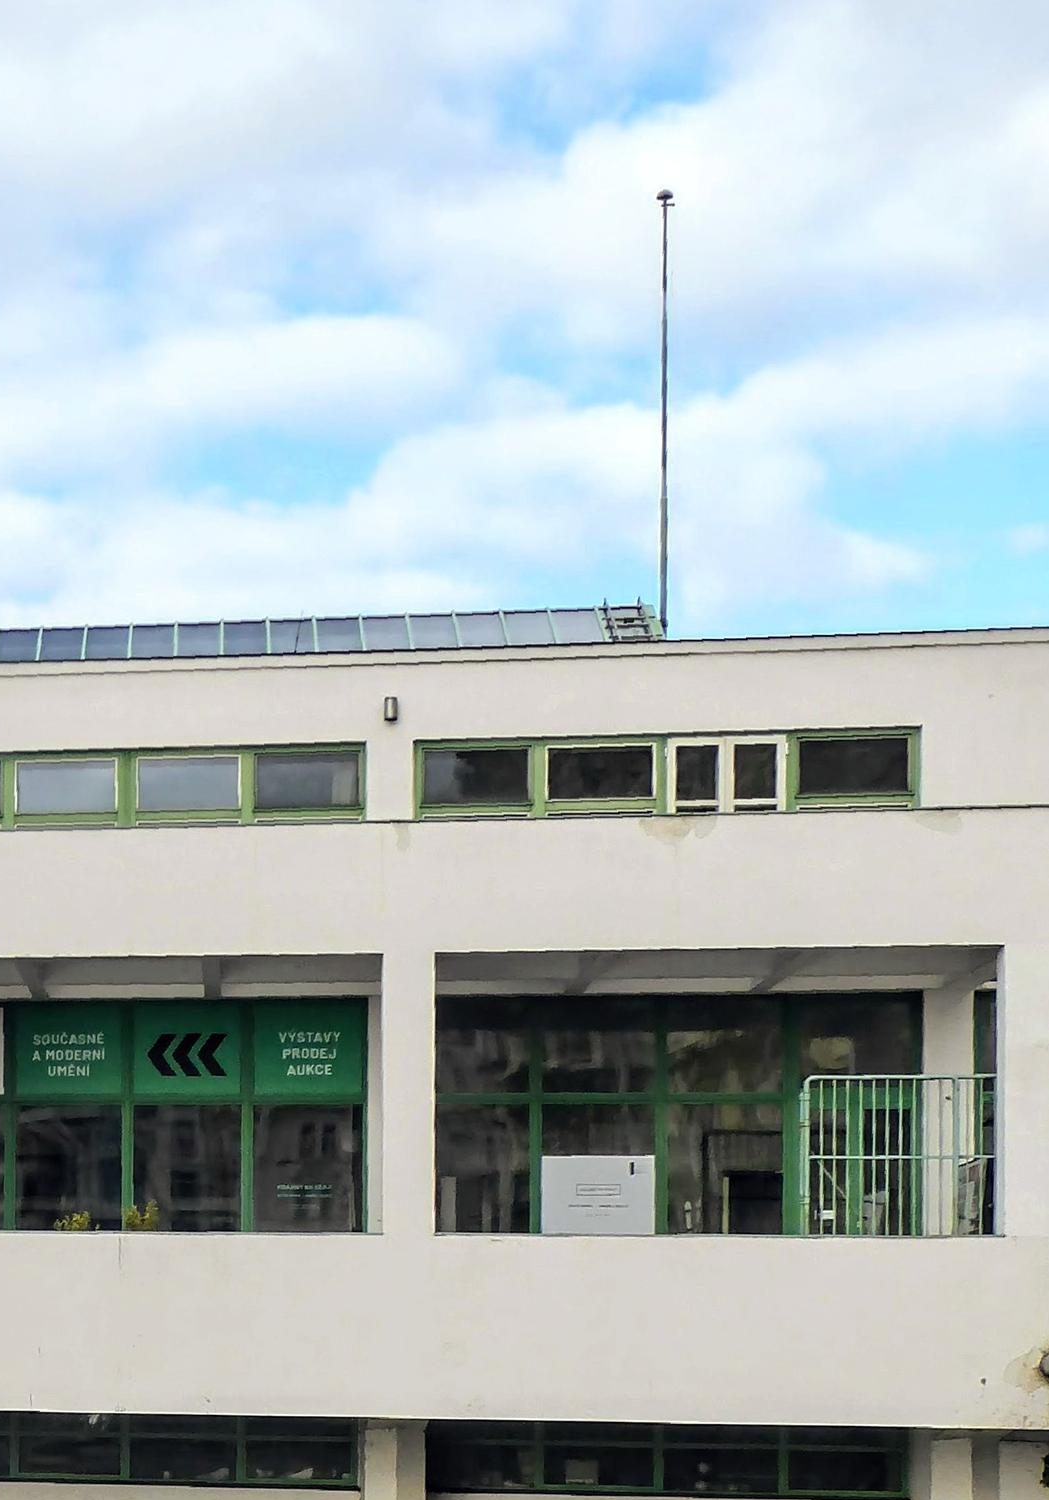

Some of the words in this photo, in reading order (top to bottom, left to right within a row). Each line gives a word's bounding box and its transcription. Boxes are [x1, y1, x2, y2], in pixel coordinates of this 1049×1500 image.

[32, 1031, 105, 1046] SOUČASNÉ
[32, 1050, 41, 1061] A
[45, 1047, 105, 1061] MODERNÍ
[282, 1047, 337, 1060] PRODEJ
[47, 1063, 91, 1077] UMĚNÍ
[286, 1064, 333, 1076] AUKCE
